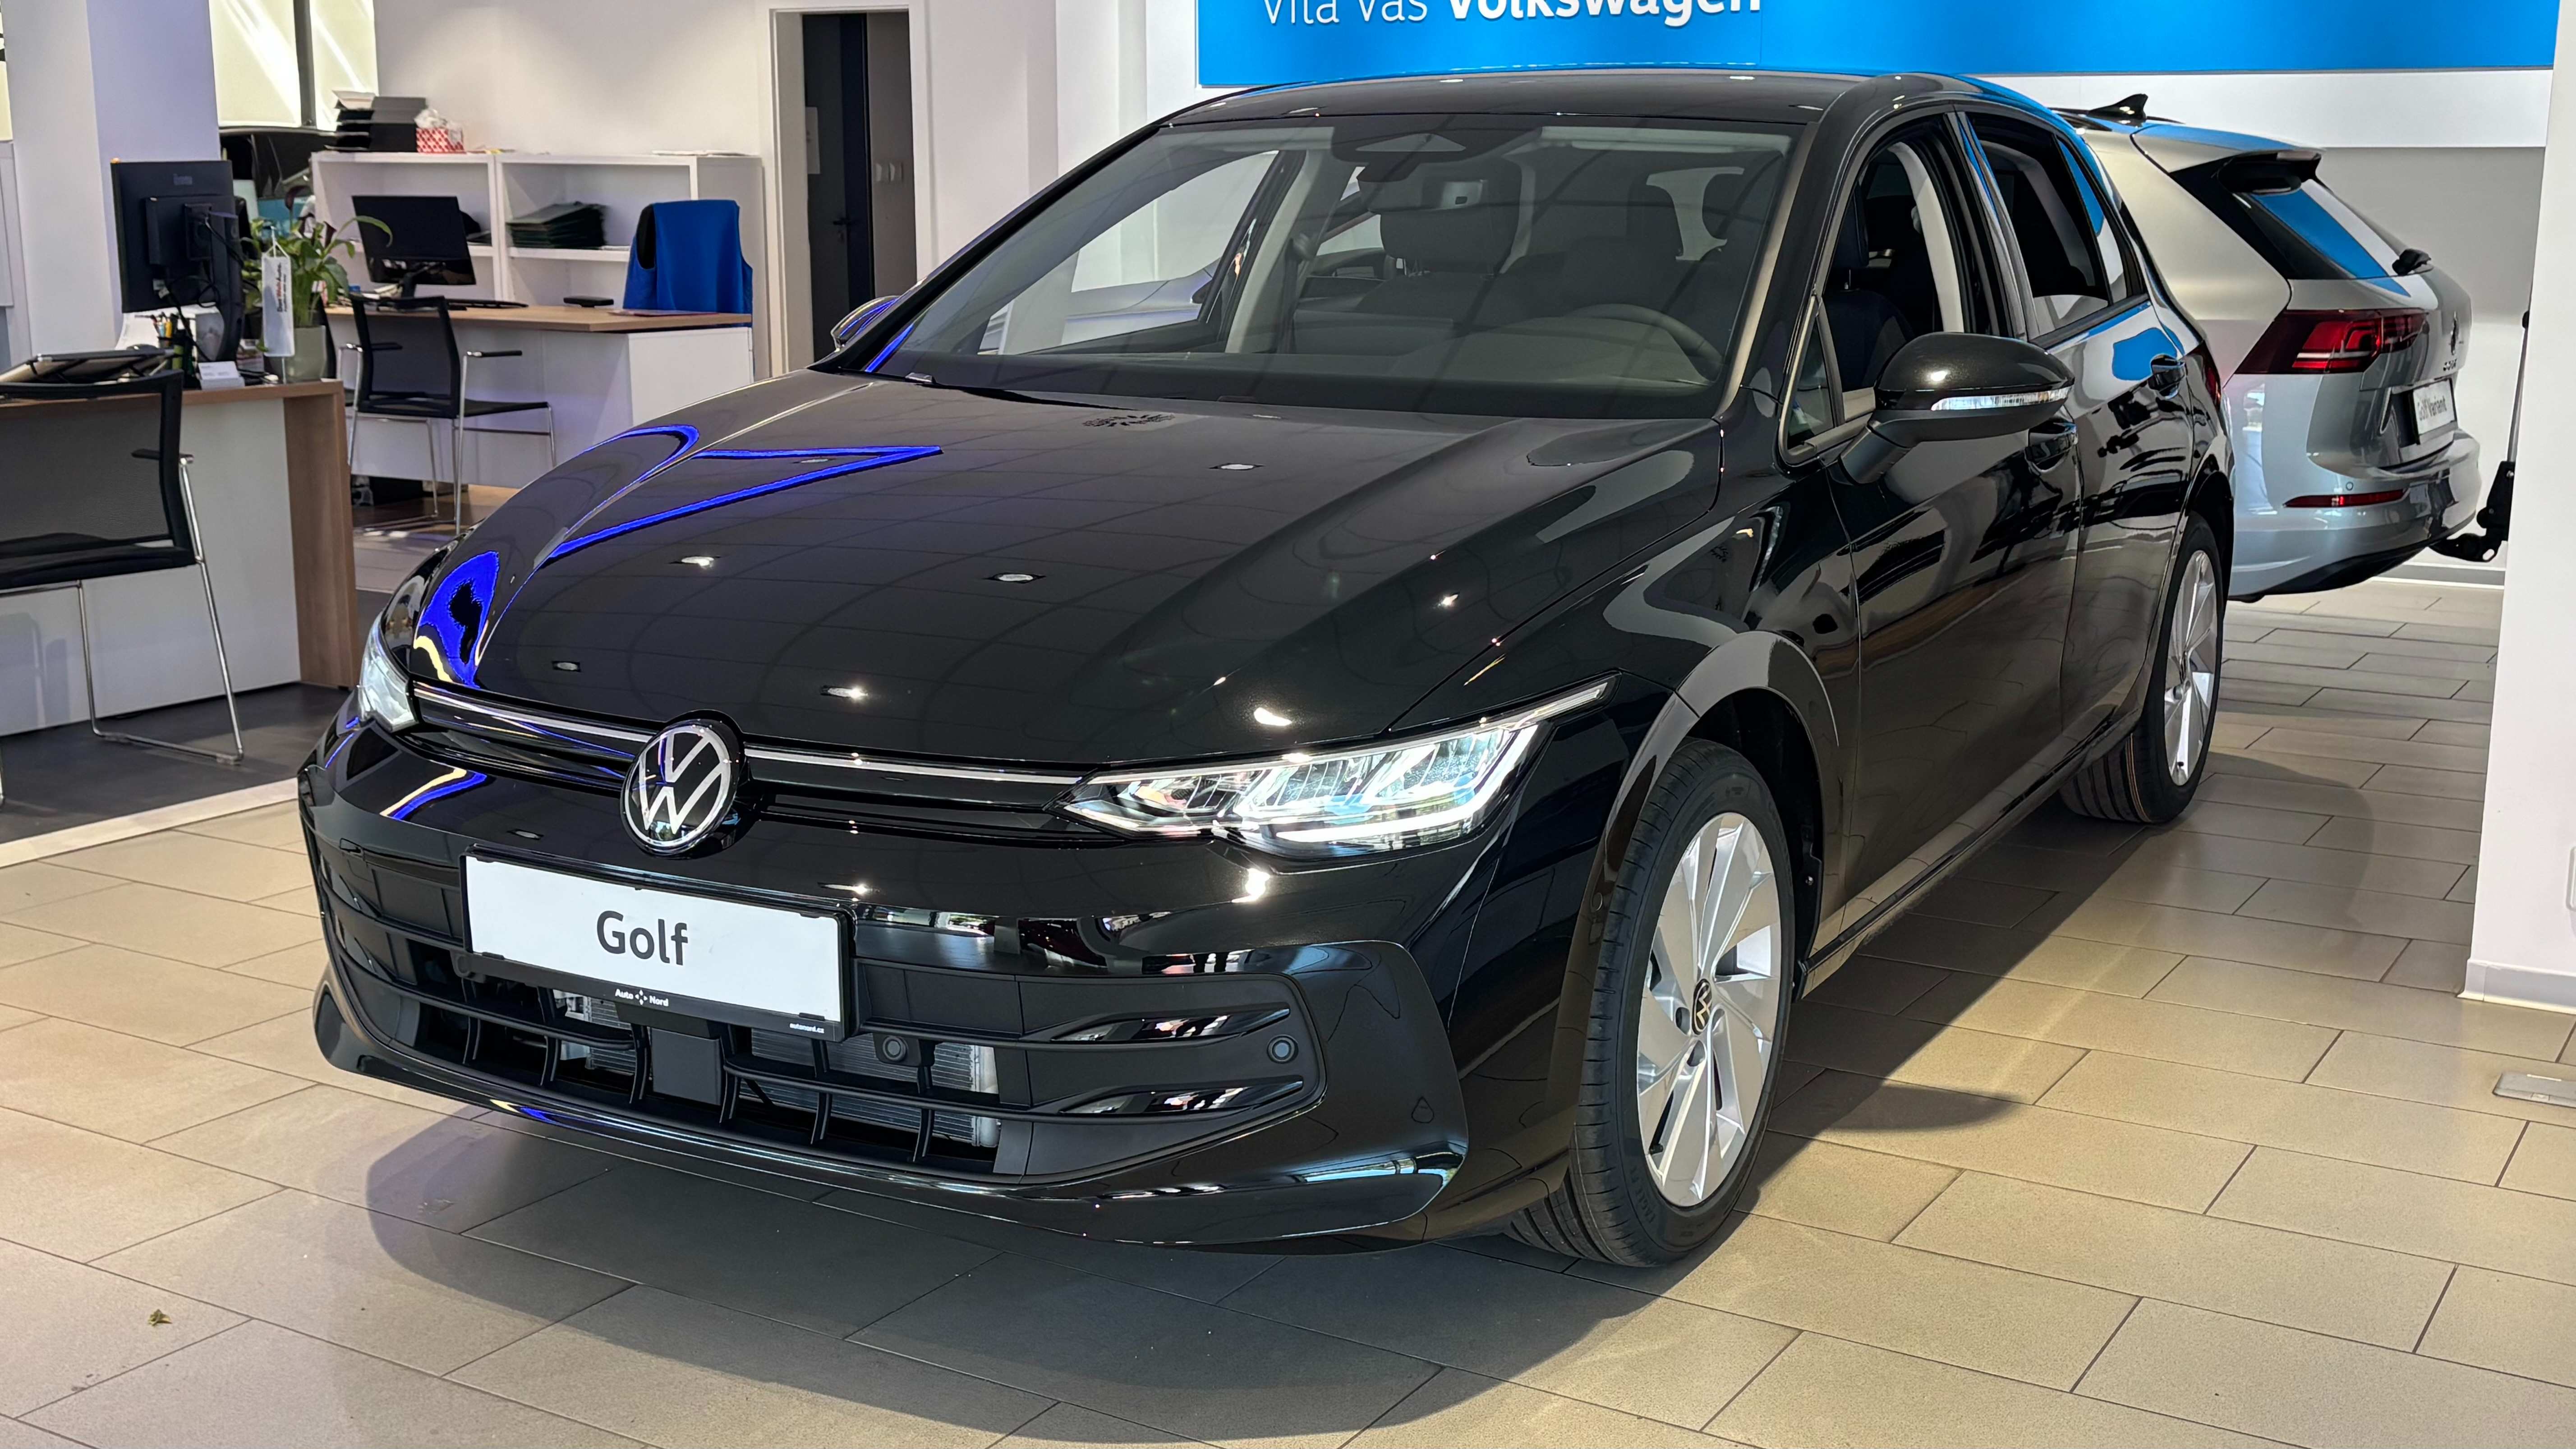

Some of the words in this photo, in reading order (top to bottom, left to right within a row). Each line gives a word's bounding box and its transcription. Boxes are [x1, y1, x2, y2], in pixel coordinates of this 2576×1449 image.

[597, 910, 688, 966] Golf
[615, 989, 634, 1000] Auto
[649, 995, 669, 1007] Nord
[789, 1022, 825, 1034] autonord.cz
